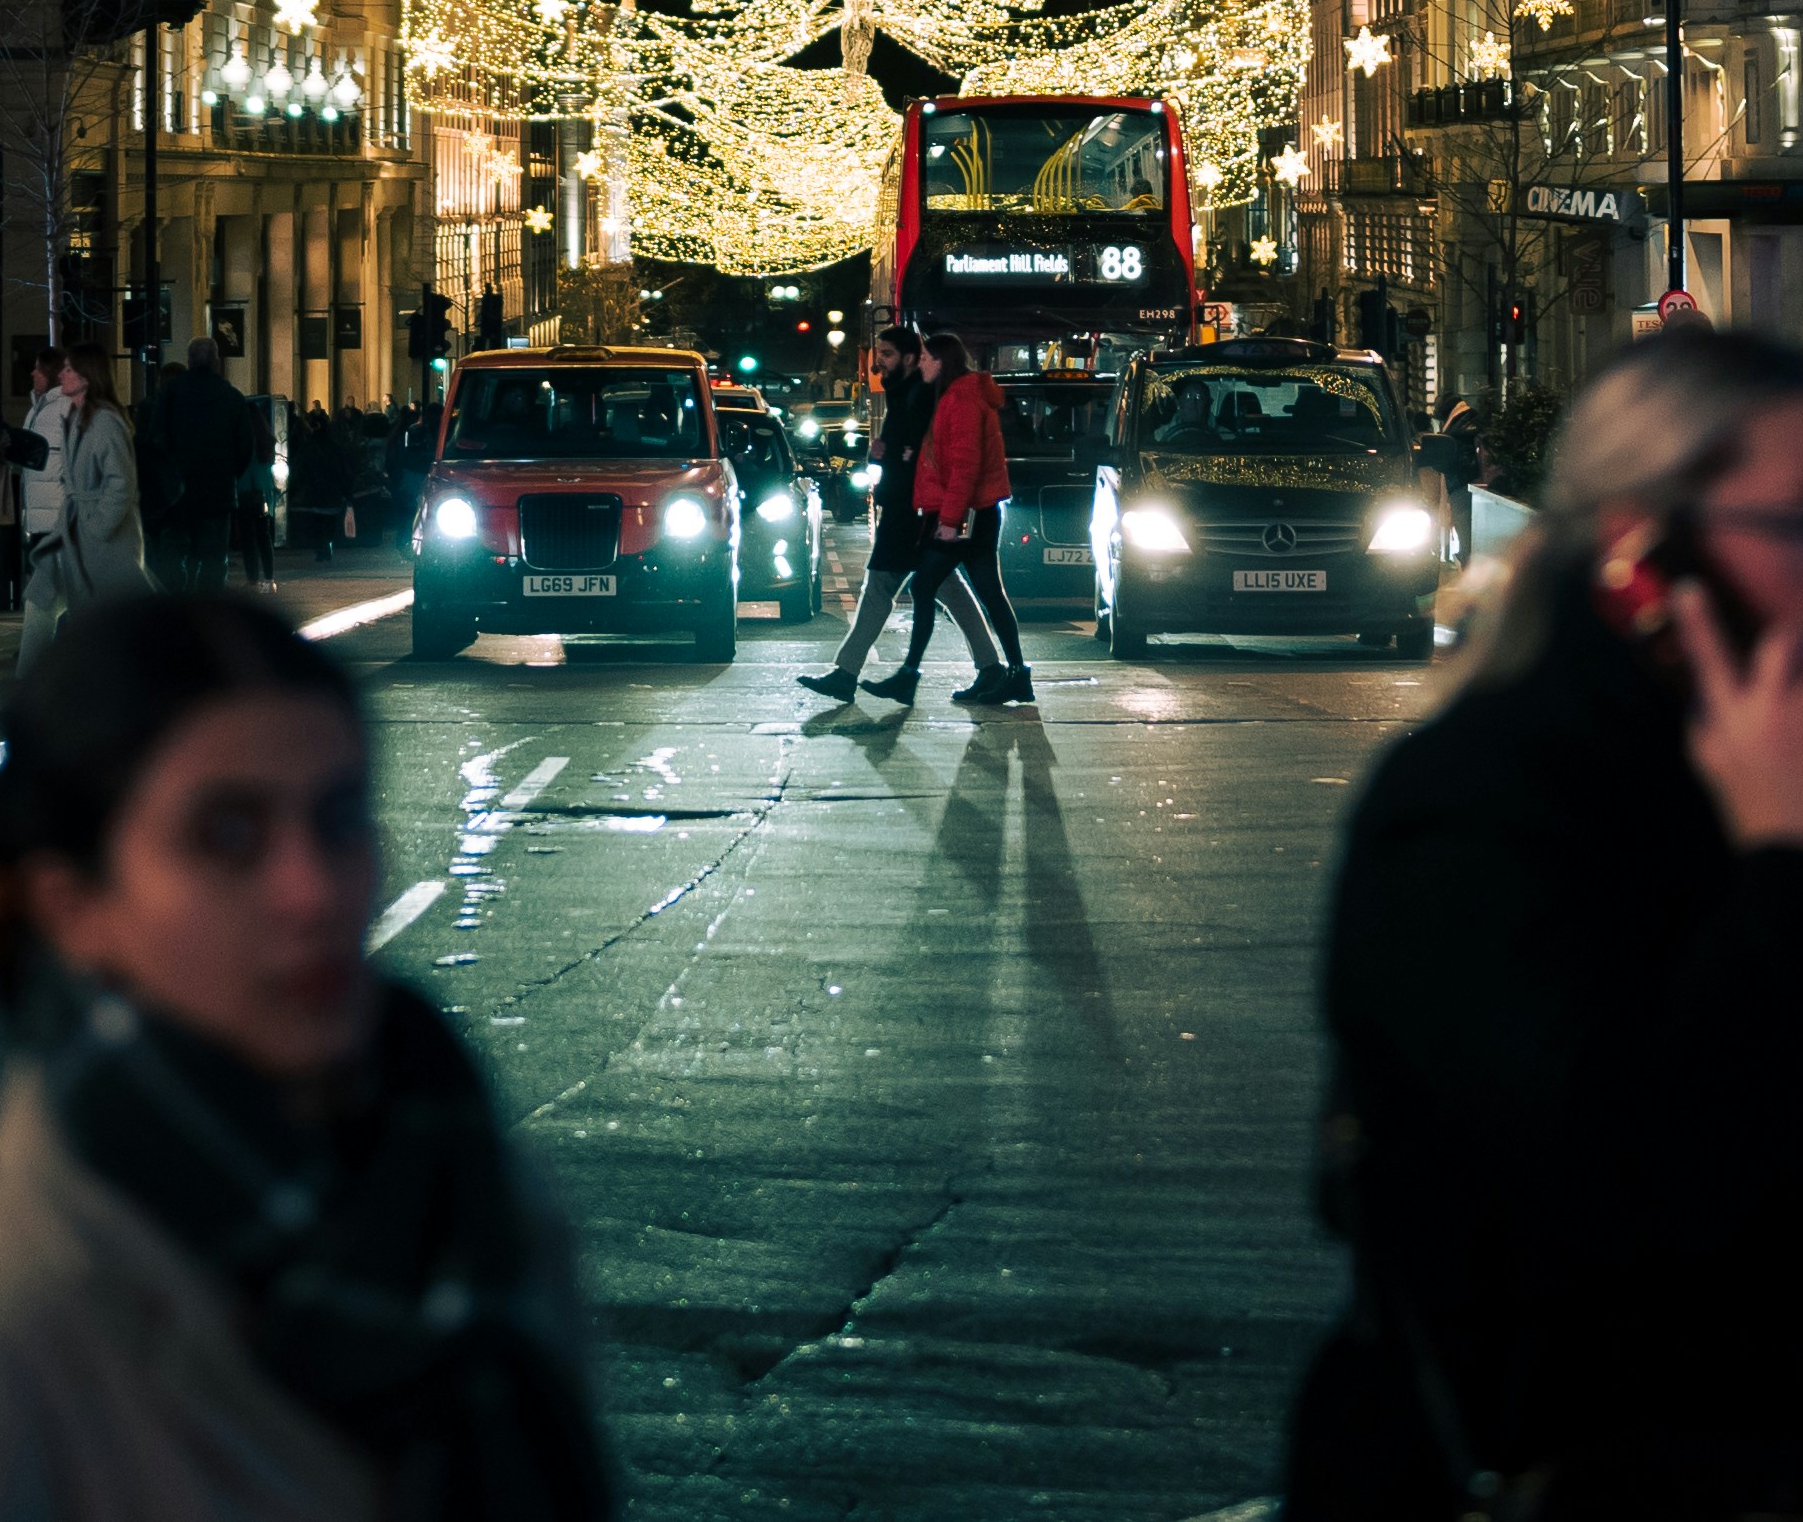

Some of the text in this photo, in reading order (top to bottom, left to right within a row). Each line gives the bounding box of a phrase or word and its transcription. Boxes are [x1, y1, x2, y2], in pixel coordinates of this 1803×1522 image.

[1527, 186, 1620, 220] CINEMA
[946, 253, 1069, 273] Parliament Hill Fields
[1101, 245, 1143, 280] 88
[1138, 309, 1176, 320] EH298
[1048, 549, 1083, 563] LJ72
[530, 576, 610, 593] LG69 JFN
[1244, 572, 1317, 588] LL15 UXE
